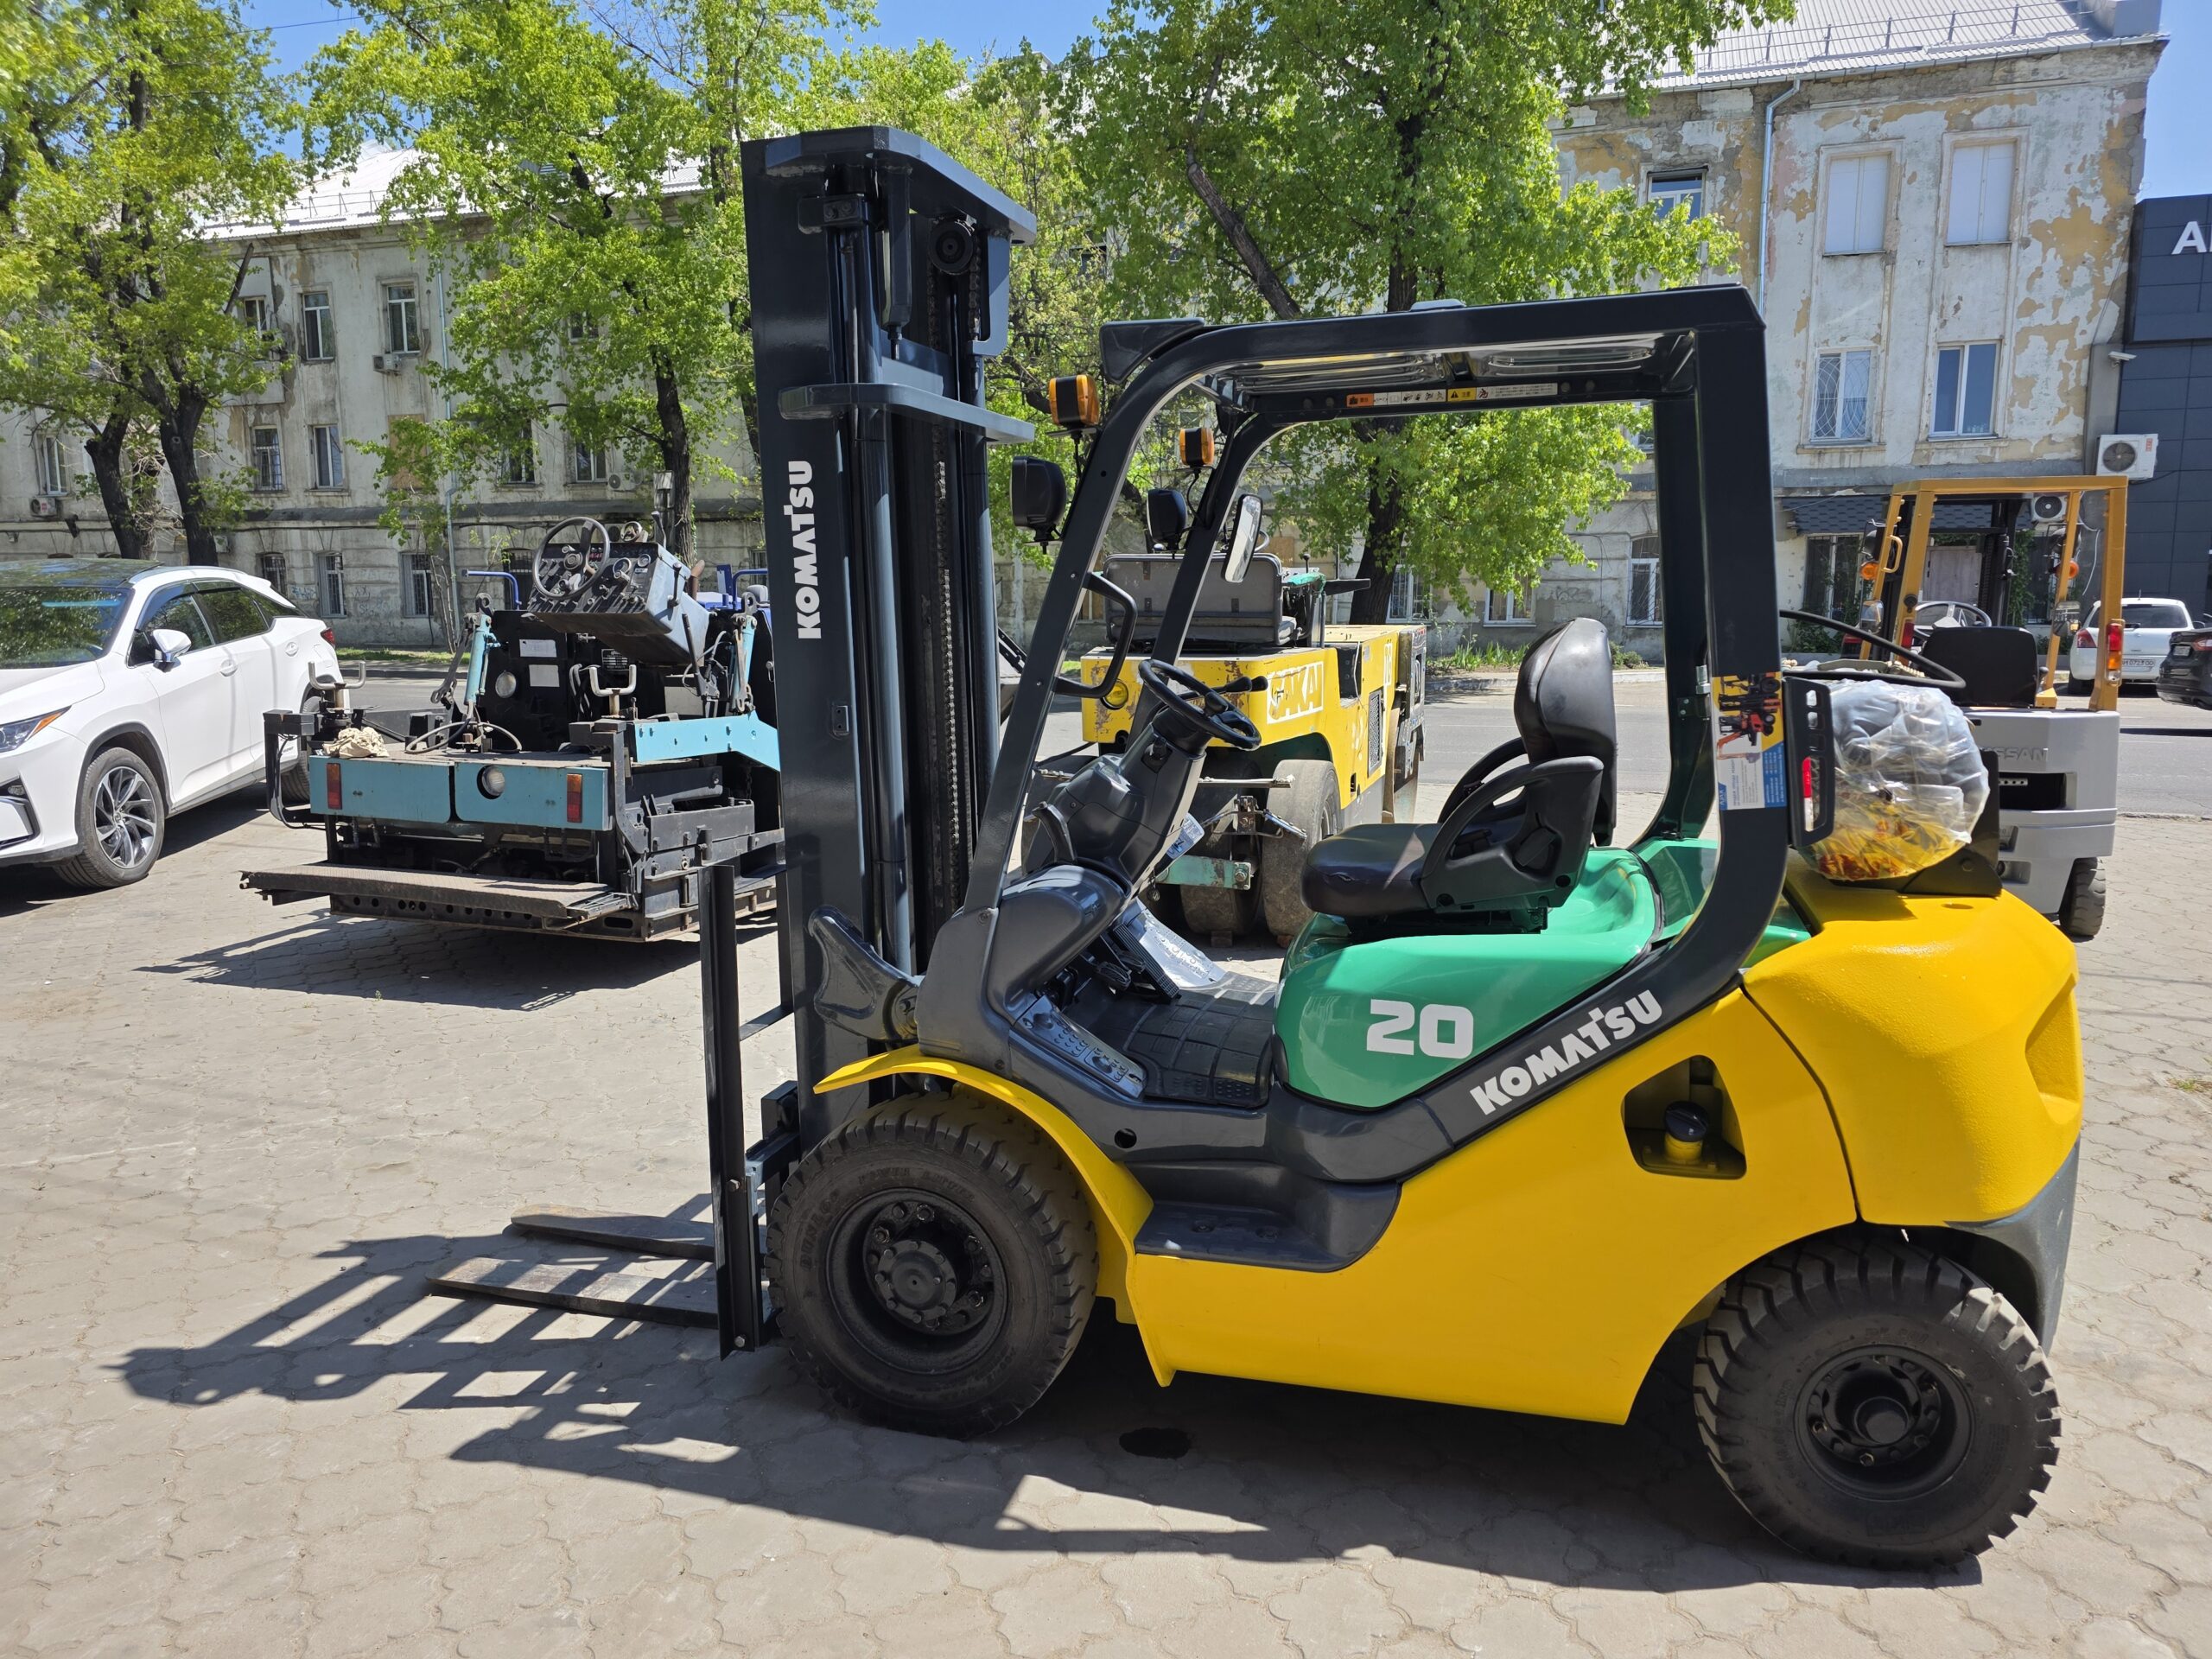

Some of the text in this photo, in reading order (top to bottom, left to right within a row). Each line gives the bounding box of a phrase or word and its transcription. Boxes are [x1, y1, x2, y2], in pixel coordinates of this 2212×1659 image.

[2171, 220, 2212, 255] A
[784, 461, 822, 639] KOMATSU
[1979, 747, 2048, 760] SSAN
[1366, 999, 1474, 1059] 20
[1470, 989, 1662, 1116] KOMATSU
[800, 1188, 840, 1272] DUNLOP
